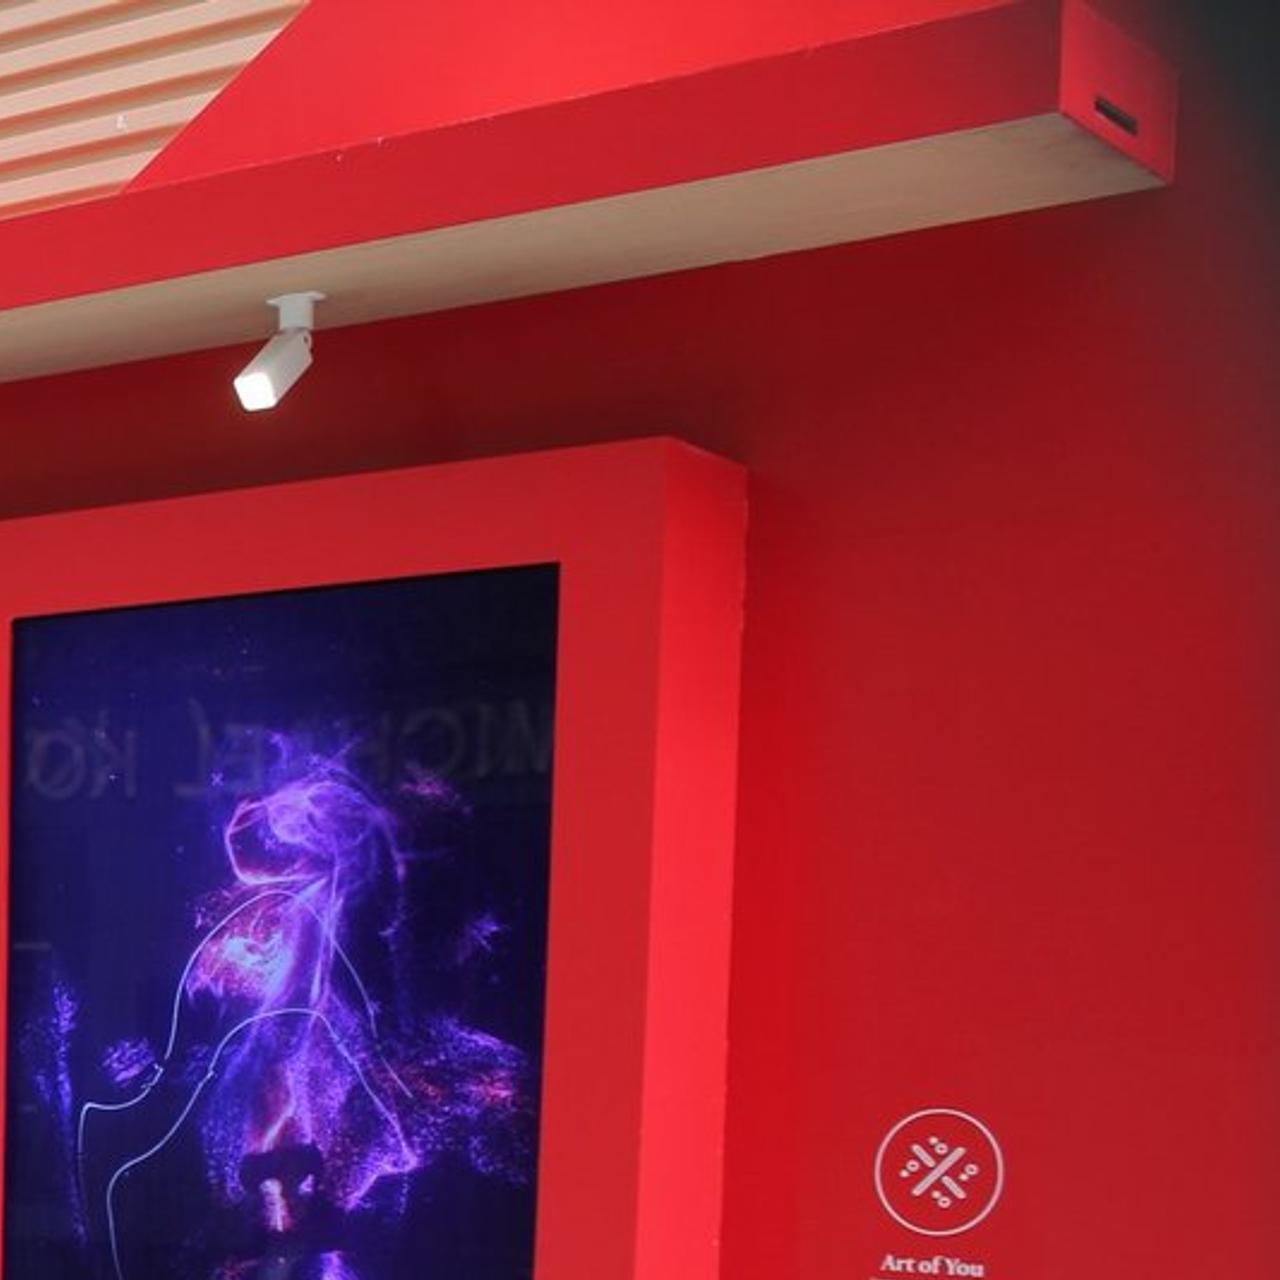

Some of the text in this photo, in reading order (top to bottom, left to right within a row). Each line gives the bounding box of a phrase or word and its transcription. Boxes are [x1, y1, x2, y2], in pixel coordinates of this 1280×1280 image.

[880, 1253, 985, 1278] Art of You
